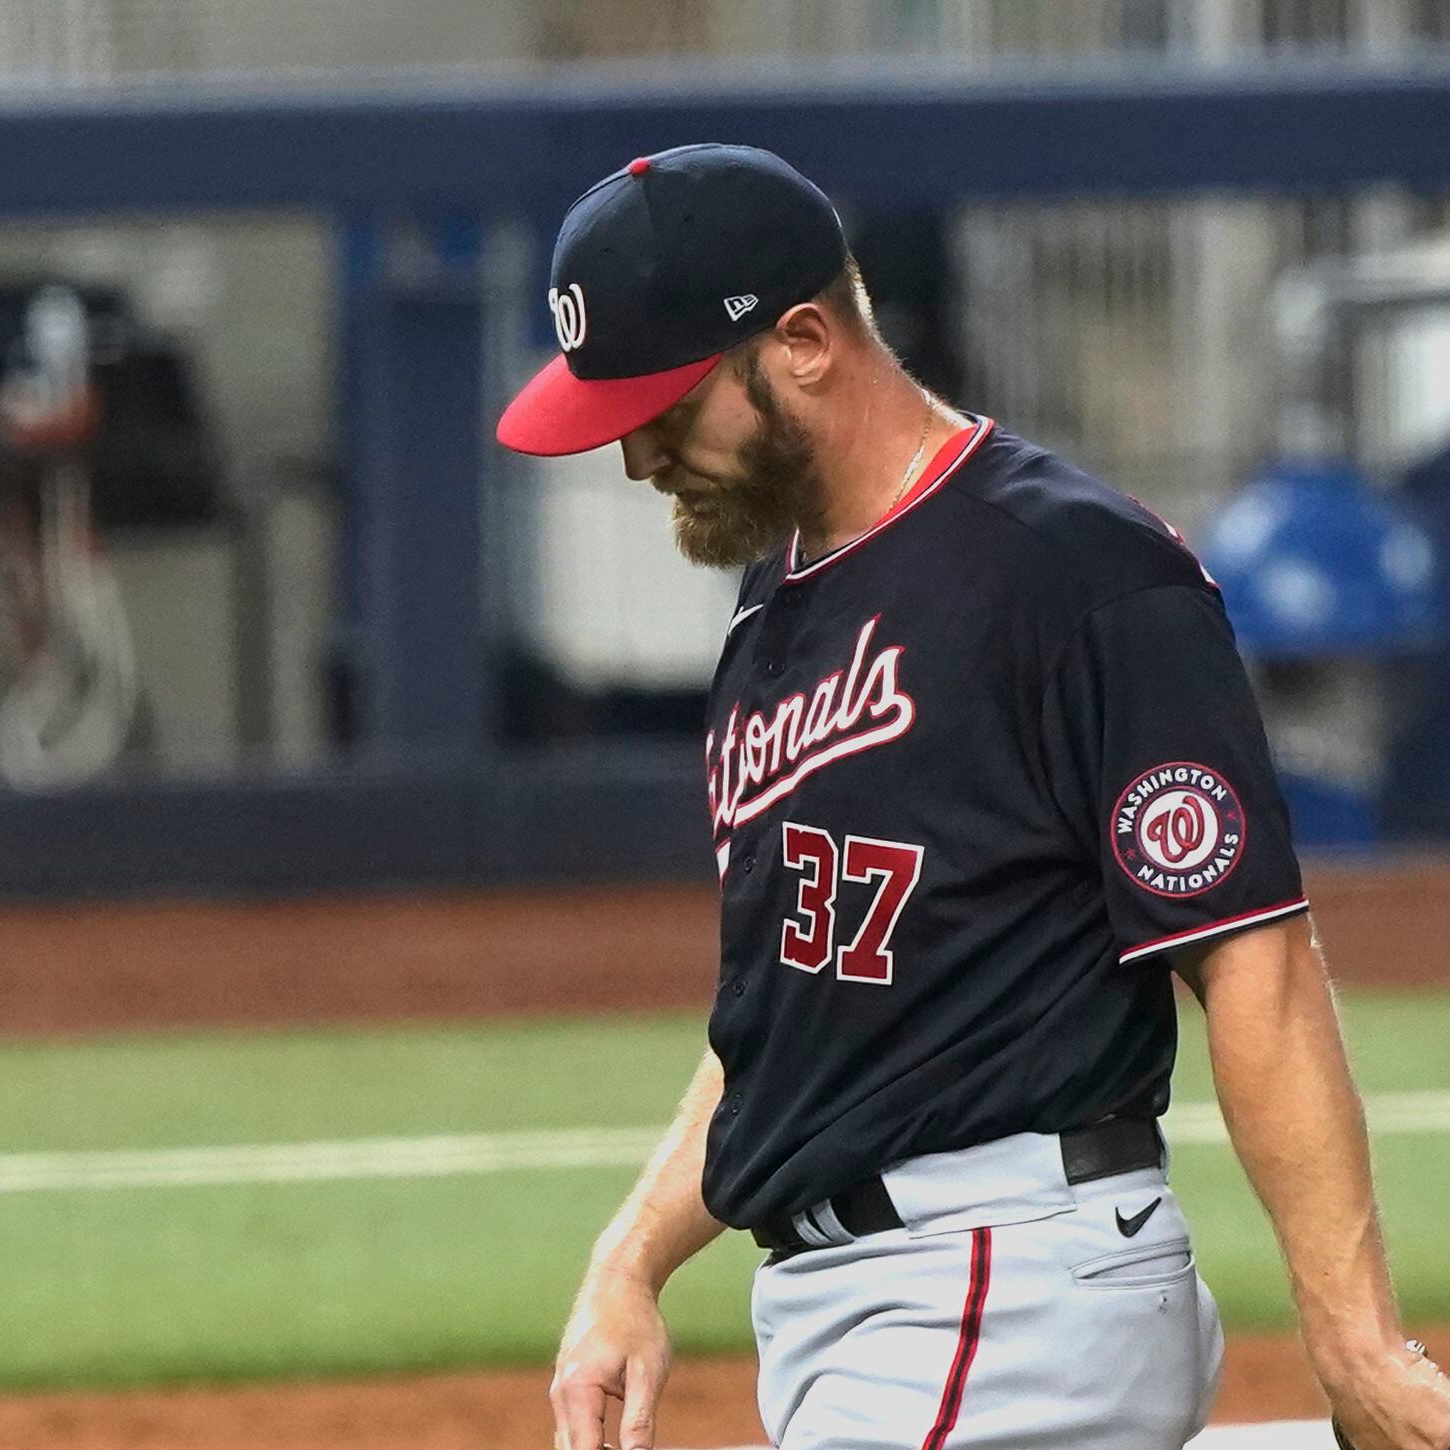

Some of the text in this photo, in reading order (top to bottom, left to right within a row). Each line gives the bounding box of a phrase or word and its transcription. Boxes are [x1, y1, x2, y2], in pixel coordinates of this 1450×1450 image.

[1117, 767, 1227, 834] WASHINGTON
[1147, 795, 1205, 863] W
[1137, 833, 1239, 892] NATIONALS
[780, 821, 925, 985] 37
